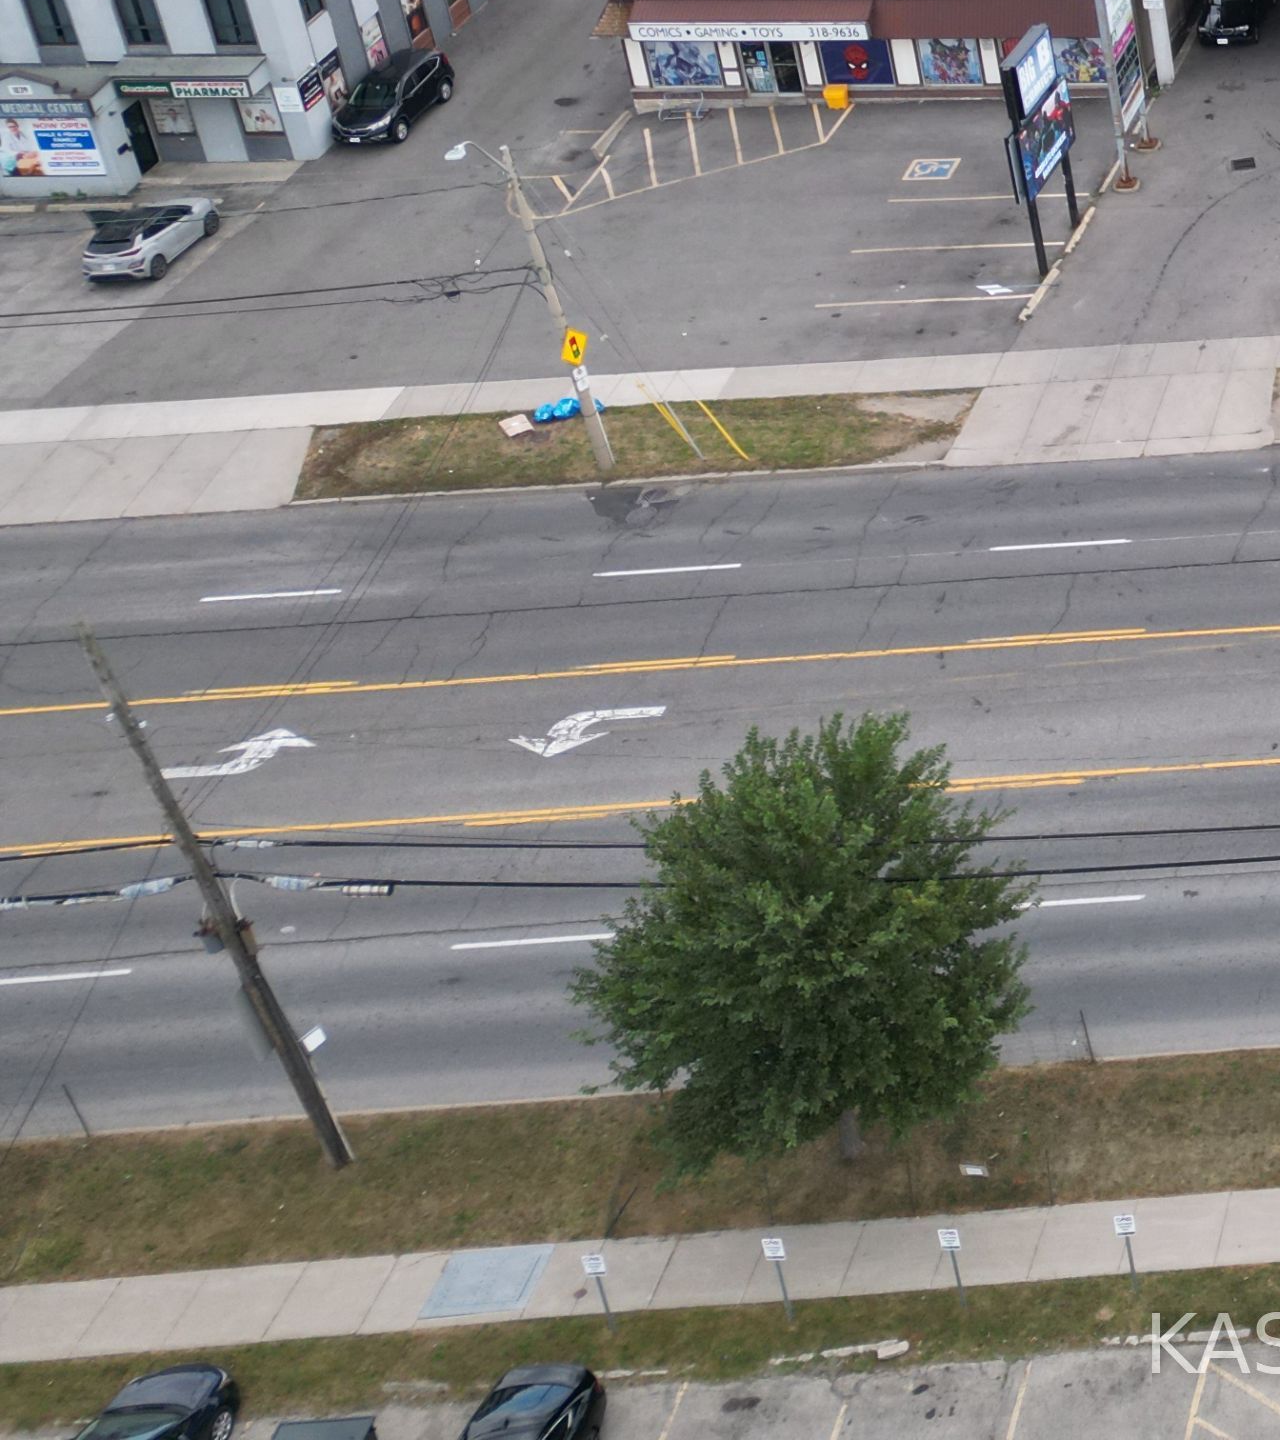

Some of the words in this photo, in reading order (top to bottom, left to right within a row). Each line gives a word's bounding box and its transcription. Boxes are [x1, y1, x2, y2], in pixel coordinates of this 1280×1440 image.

[638, 28, 682, 37] COMICS
[694, 27, 738, 37] GAMING
[751, 27, 783, 37] TOYS
[808, 27, 860, 37] 318-9636
[175, 87, 245, 97] PHARMACY
